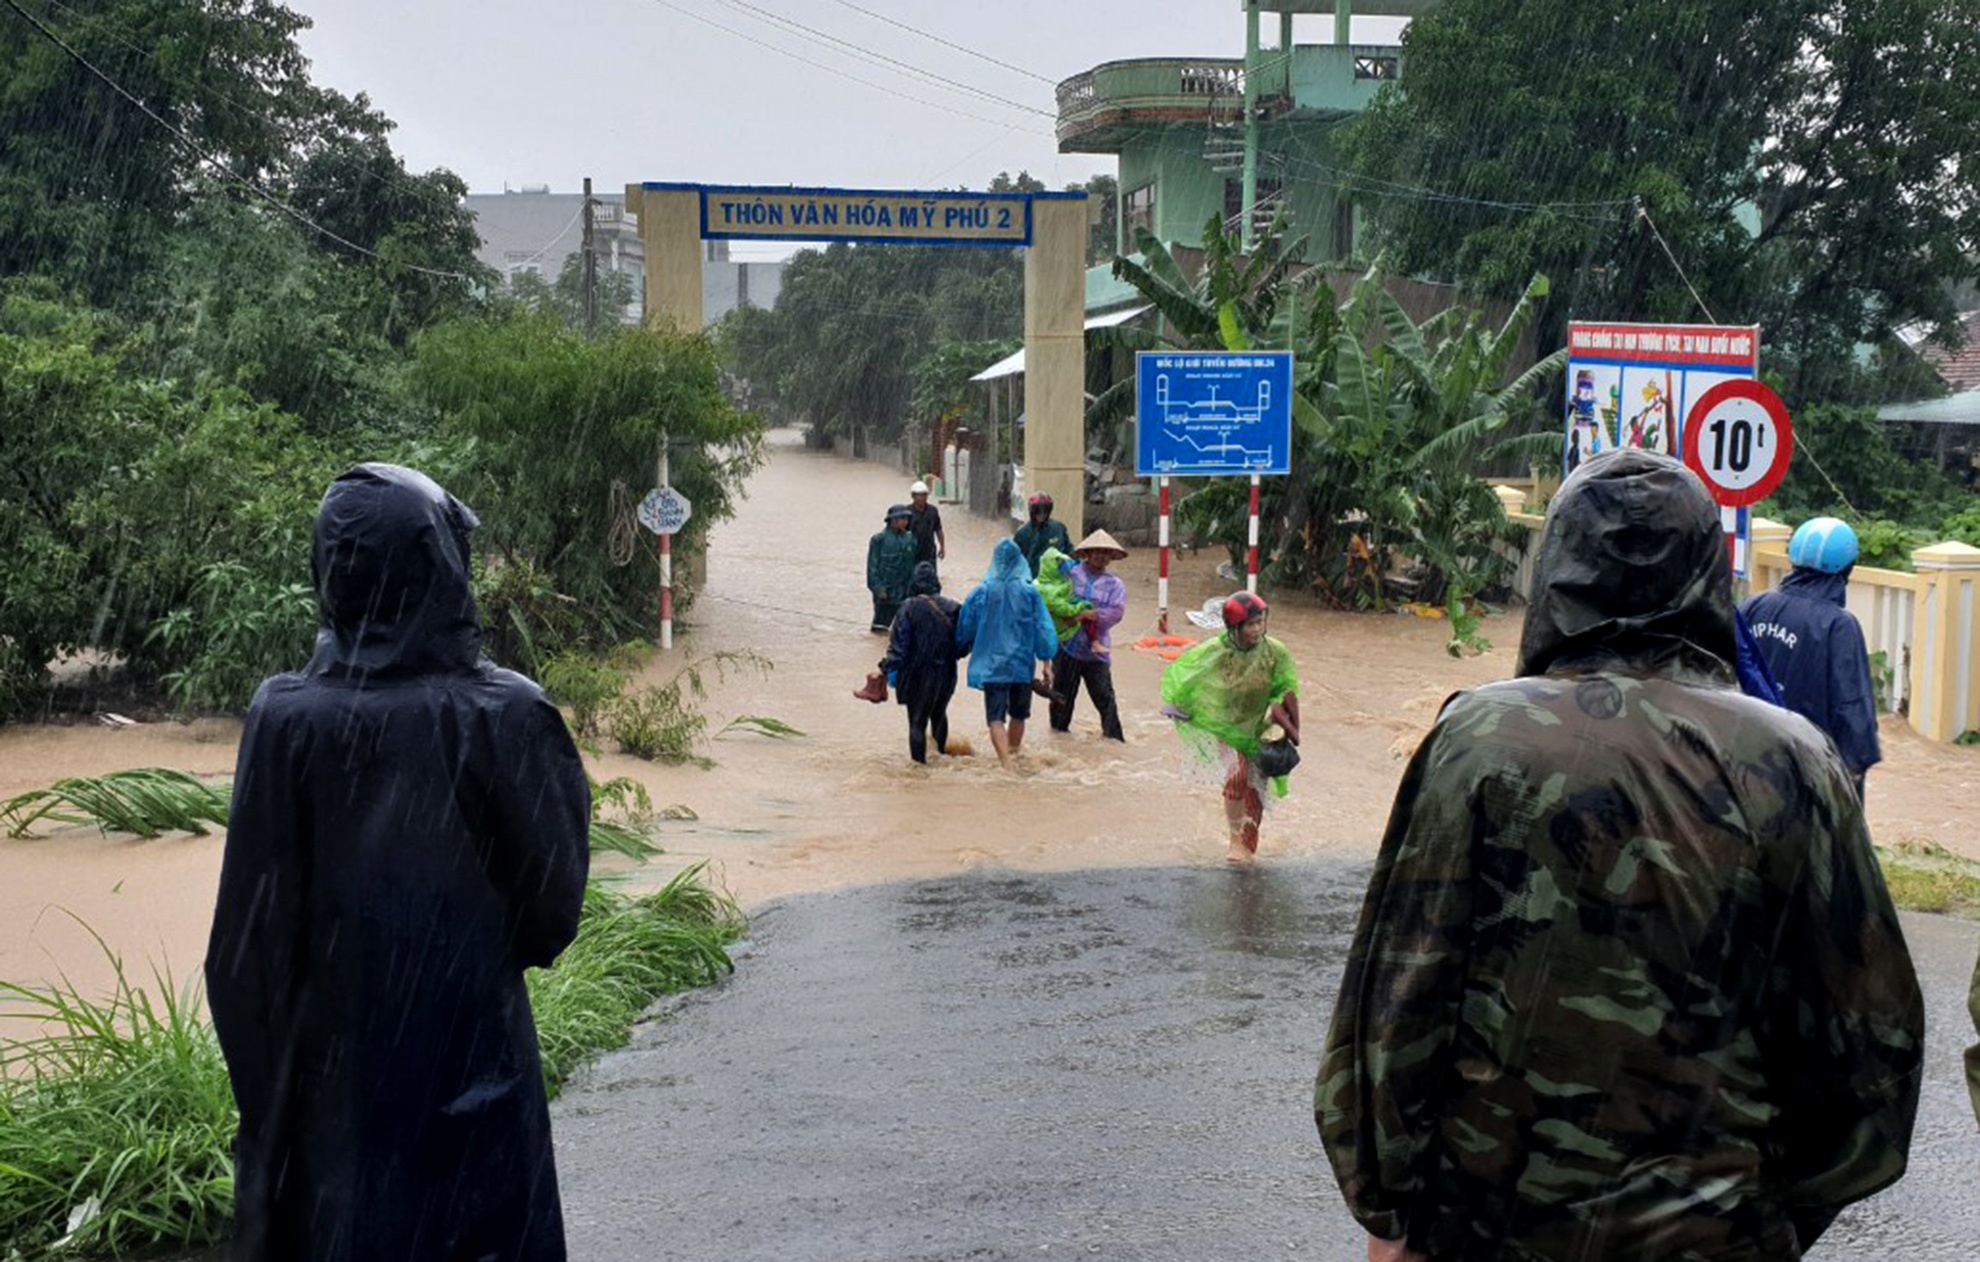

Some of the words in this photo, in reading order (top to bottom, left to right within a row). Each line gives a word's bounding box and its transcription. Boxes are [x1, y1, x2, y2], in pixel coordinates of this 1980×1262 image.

[720, 196, 783, 225] THÔN
[790, 200, 838, 225] VĂN
[846, 199, 892, 227] HÓA
[900, 200, 936, 228] MỸ
[945, 201, 989, 228] PHÚ
[997, 208, 1011, 229] 2
